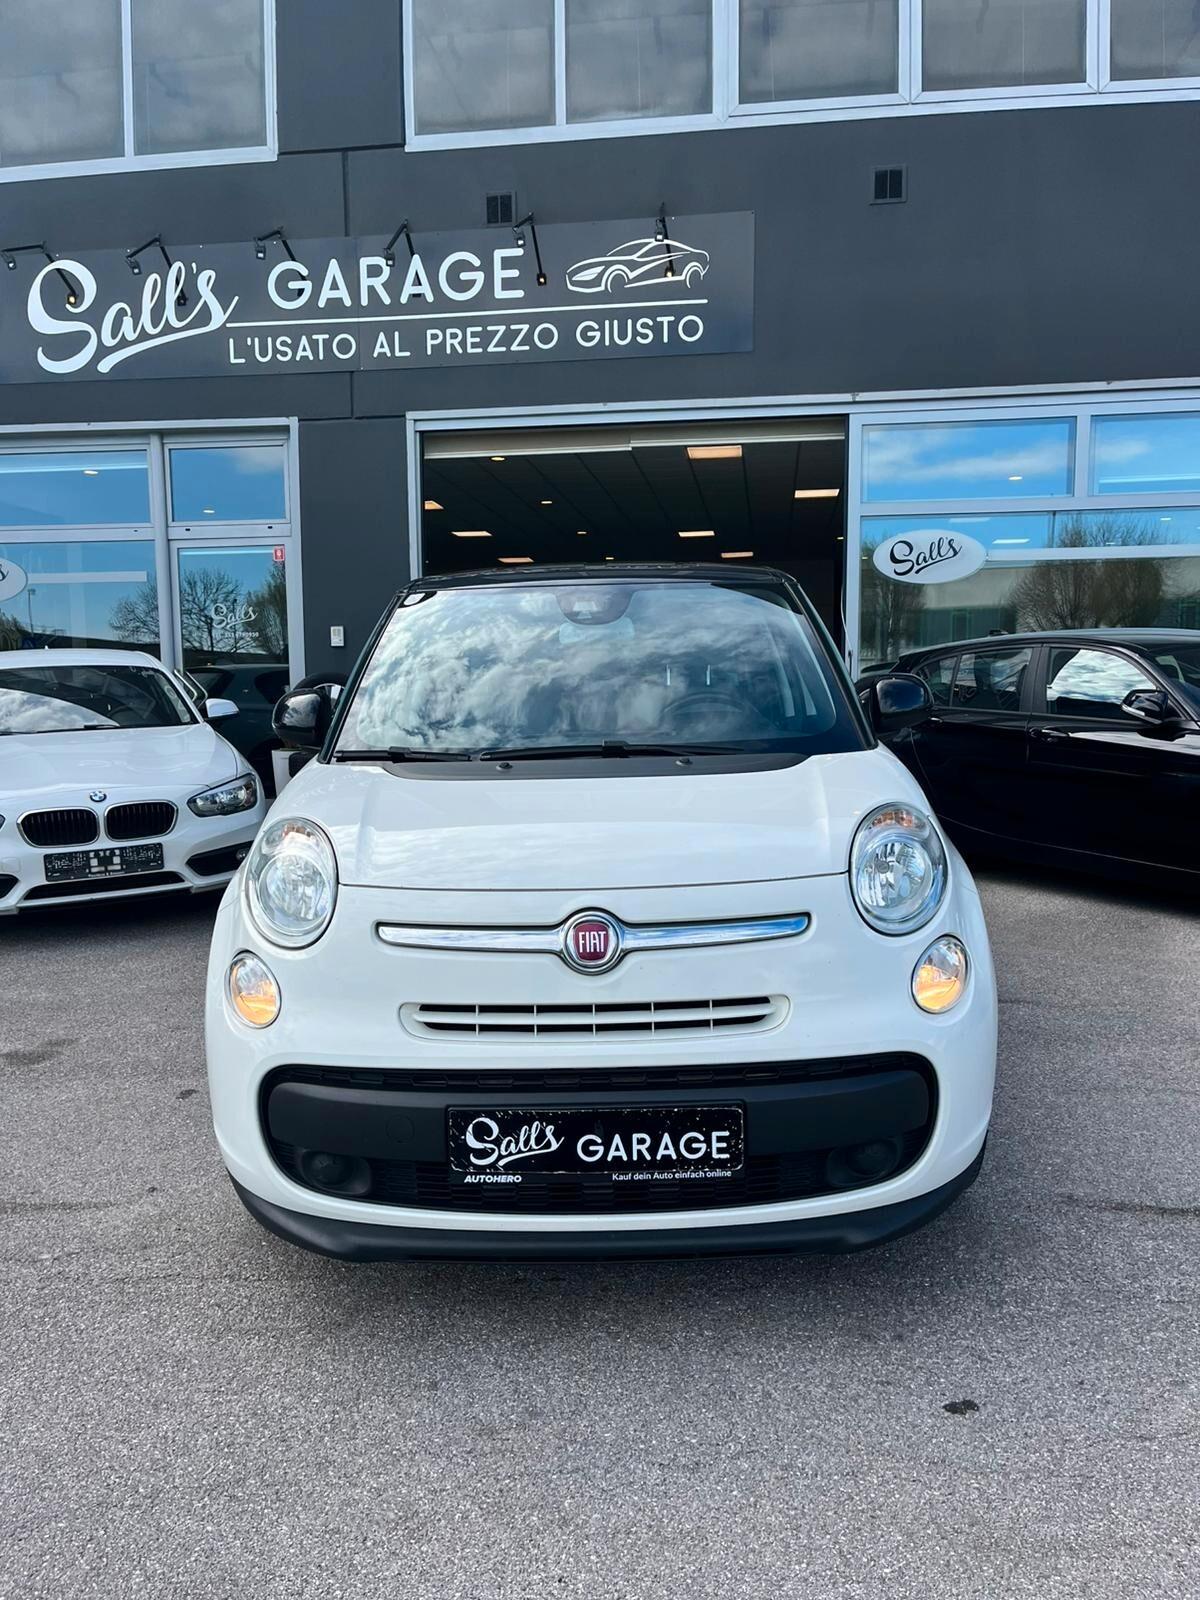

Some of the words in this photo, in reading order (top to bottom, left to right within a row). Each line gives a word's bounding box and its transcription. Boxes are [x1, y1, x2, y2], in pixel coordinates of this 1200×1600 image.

[27, 259, 239, 373] Sall's
[267, 248, 524, 310] GARAGE
[229, 333, 357, 364] L'USATO
[373, 331, 411, 358] AL
[426, 323, 559, 355] PREZZO
[575, 314, 704, 348] GIUSTO
[889, 536, 963, 576] Sall's
[578, 931, 606, 953] FIAT
[465, 1117, 565, 1167] Sall's
[576, 1130, 730, 1163] GARAGE
[463, 1174, 522, 1184] AUTOHERO
[612, 1171, 632, 1181] Kauf
[633, 1171, 652, 1180] dein
[653, 1170, 674, 1180] Auto
[674, 1168, 705, 1179] einfach
[706, 1167, 732, 1178] online
